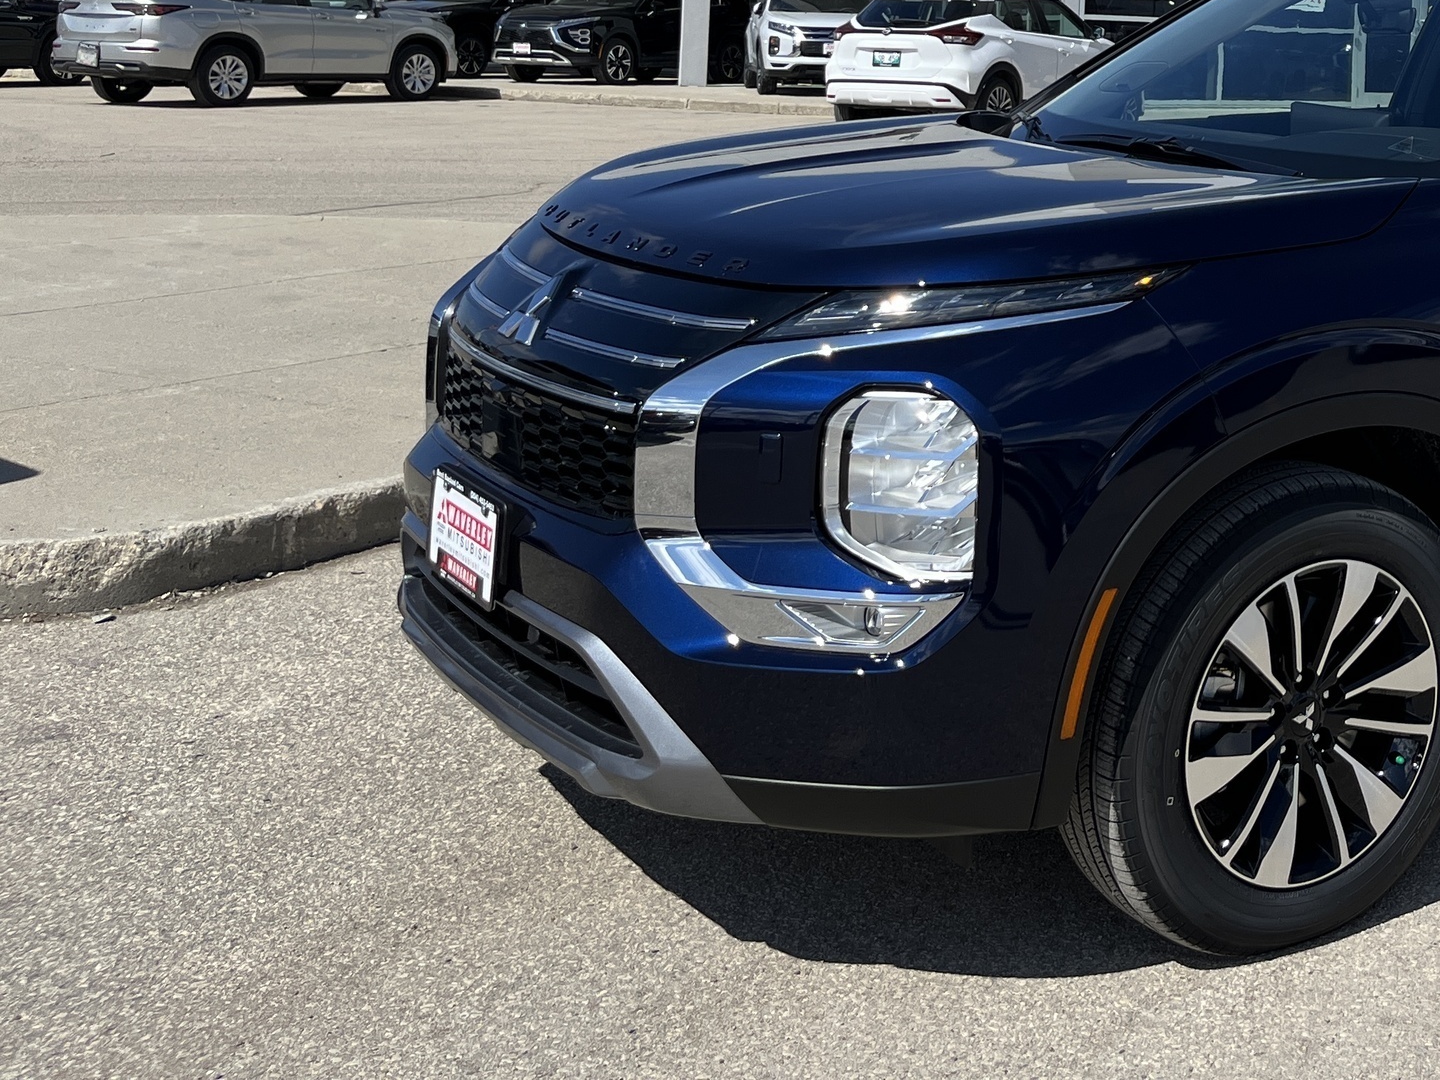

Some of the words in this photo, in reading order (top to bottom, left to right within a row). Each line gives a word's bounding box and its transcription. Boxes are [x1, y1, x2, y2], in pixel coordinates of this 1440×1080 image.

[446, 502, 493, 550] WAVERLEY
[447, 527, 491, 567] MITSUBISHI
[446, 556, 478, 590] WAVERLEY
